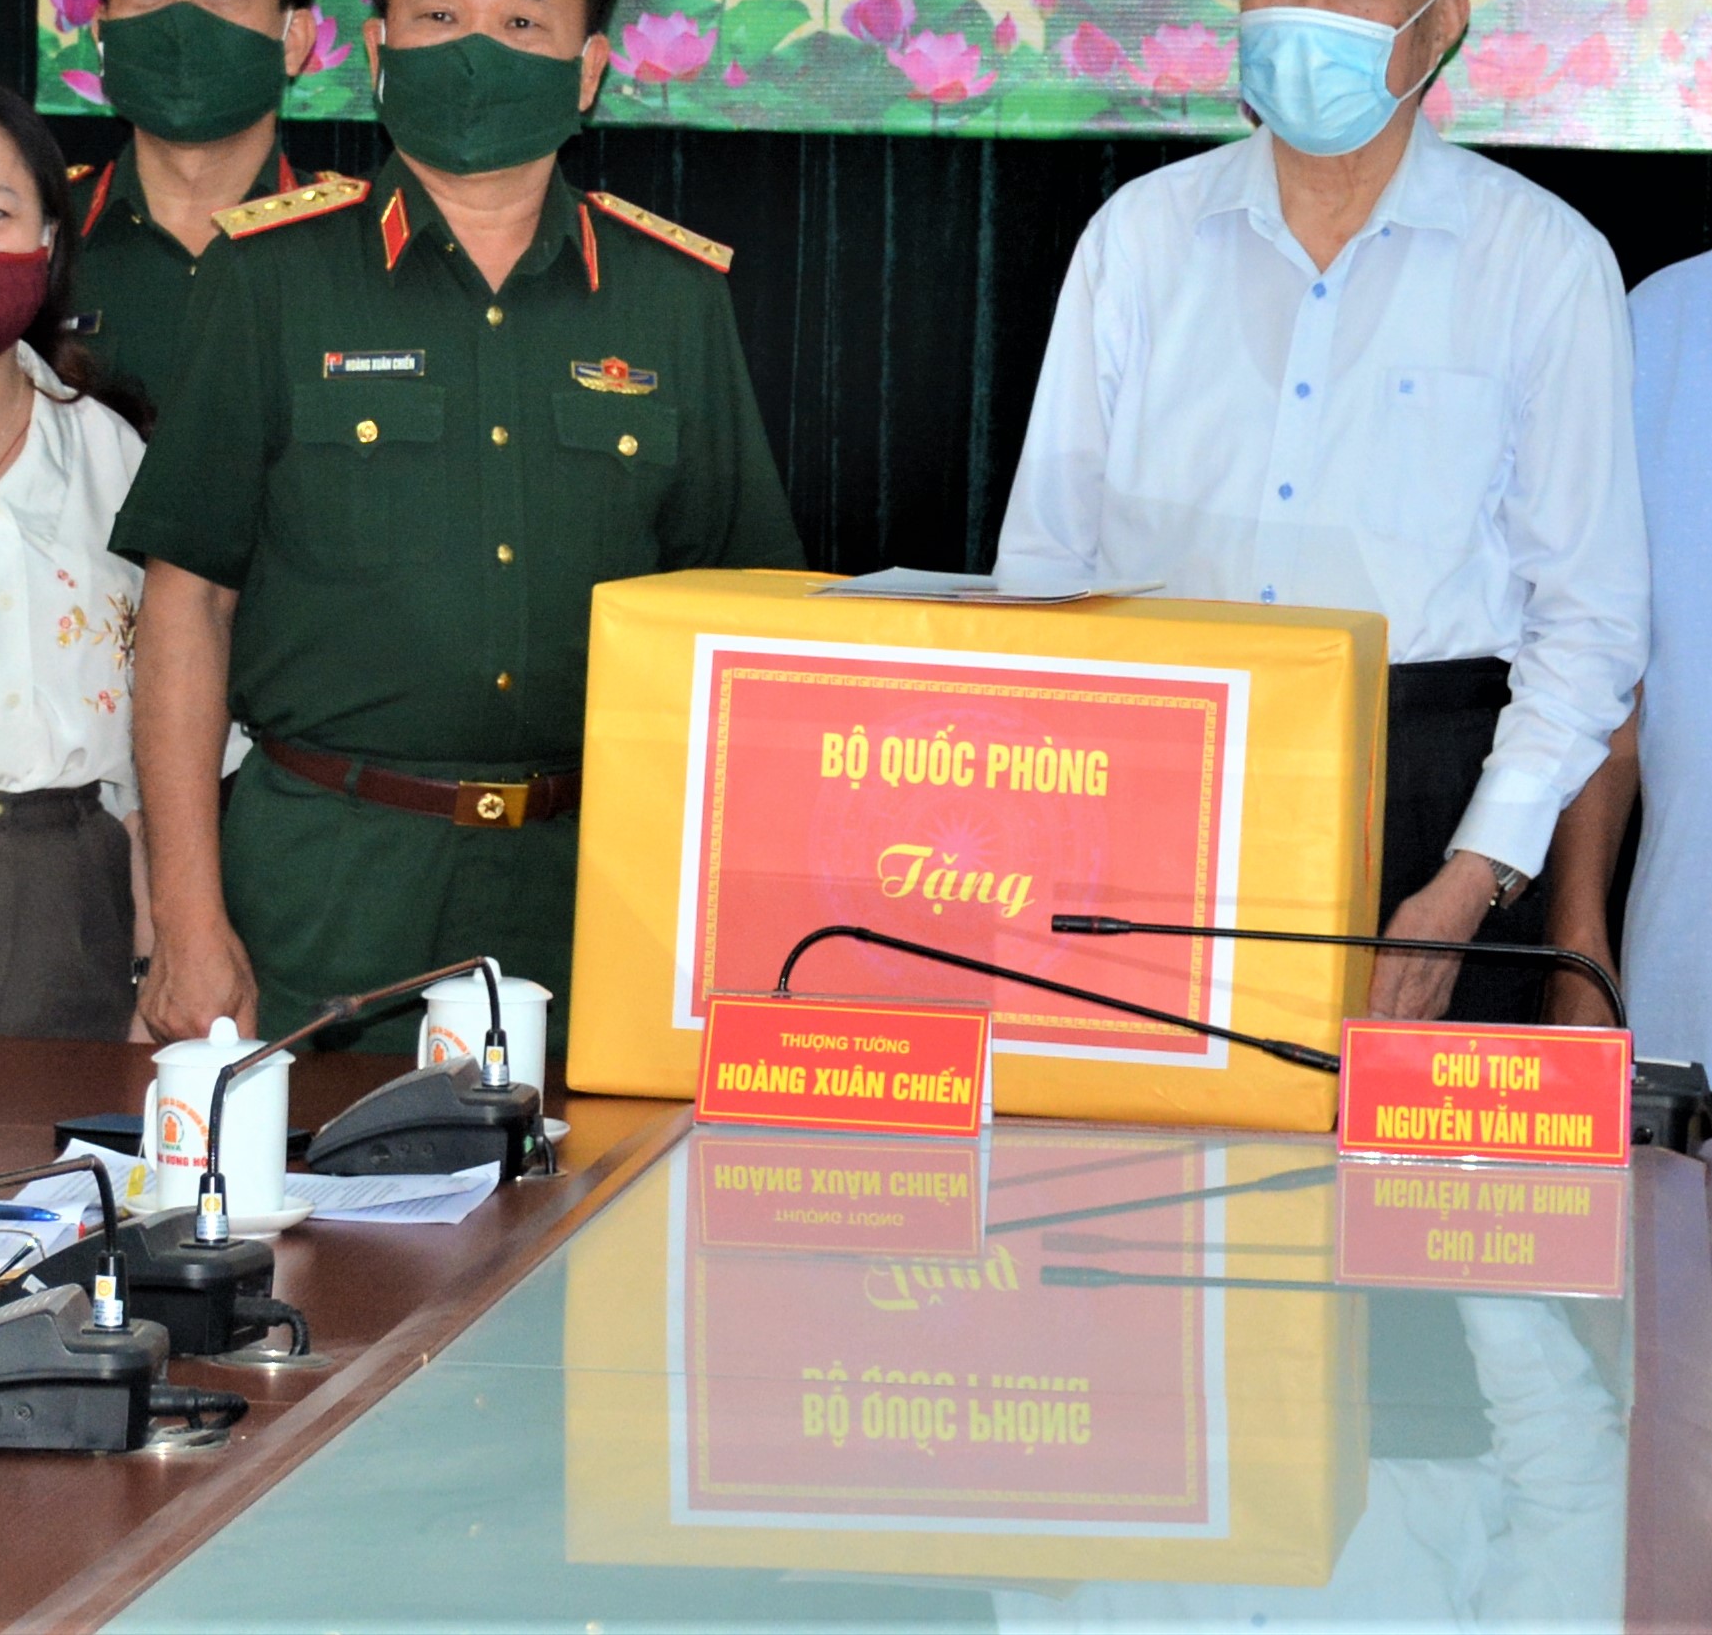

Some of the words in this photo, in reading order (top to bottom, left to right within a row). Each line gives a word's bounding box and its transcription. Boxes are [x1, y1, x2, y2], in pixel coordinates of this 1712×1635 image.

[820, 724, 870, 790] BỘ
[879, 724, 976, 788] QUỐC
[985, 735, 1110, 797] PHÒNG
[876, 843, 1036, 919] Tặng
[780, 1032, 849, 1052] THƯỢNG
[853, 1035, 910, 1054] TƯỚNG
[1431, 1039, 1480, 1089] CHỦ
[1487, 1054, 1540, 1097] TỊCH
[717, 1059, 807, 1095] HOÀNG
[812, 1064, 886, 1099] XUÂN
[892, 1066, 972, 1105] CHIẾN
[1375, 1095, 1473, 1142] NGUYỄN
[1479, 1104, 1528, 1145] VĂN
[1535, 1112, 1593, 1148] RINH
